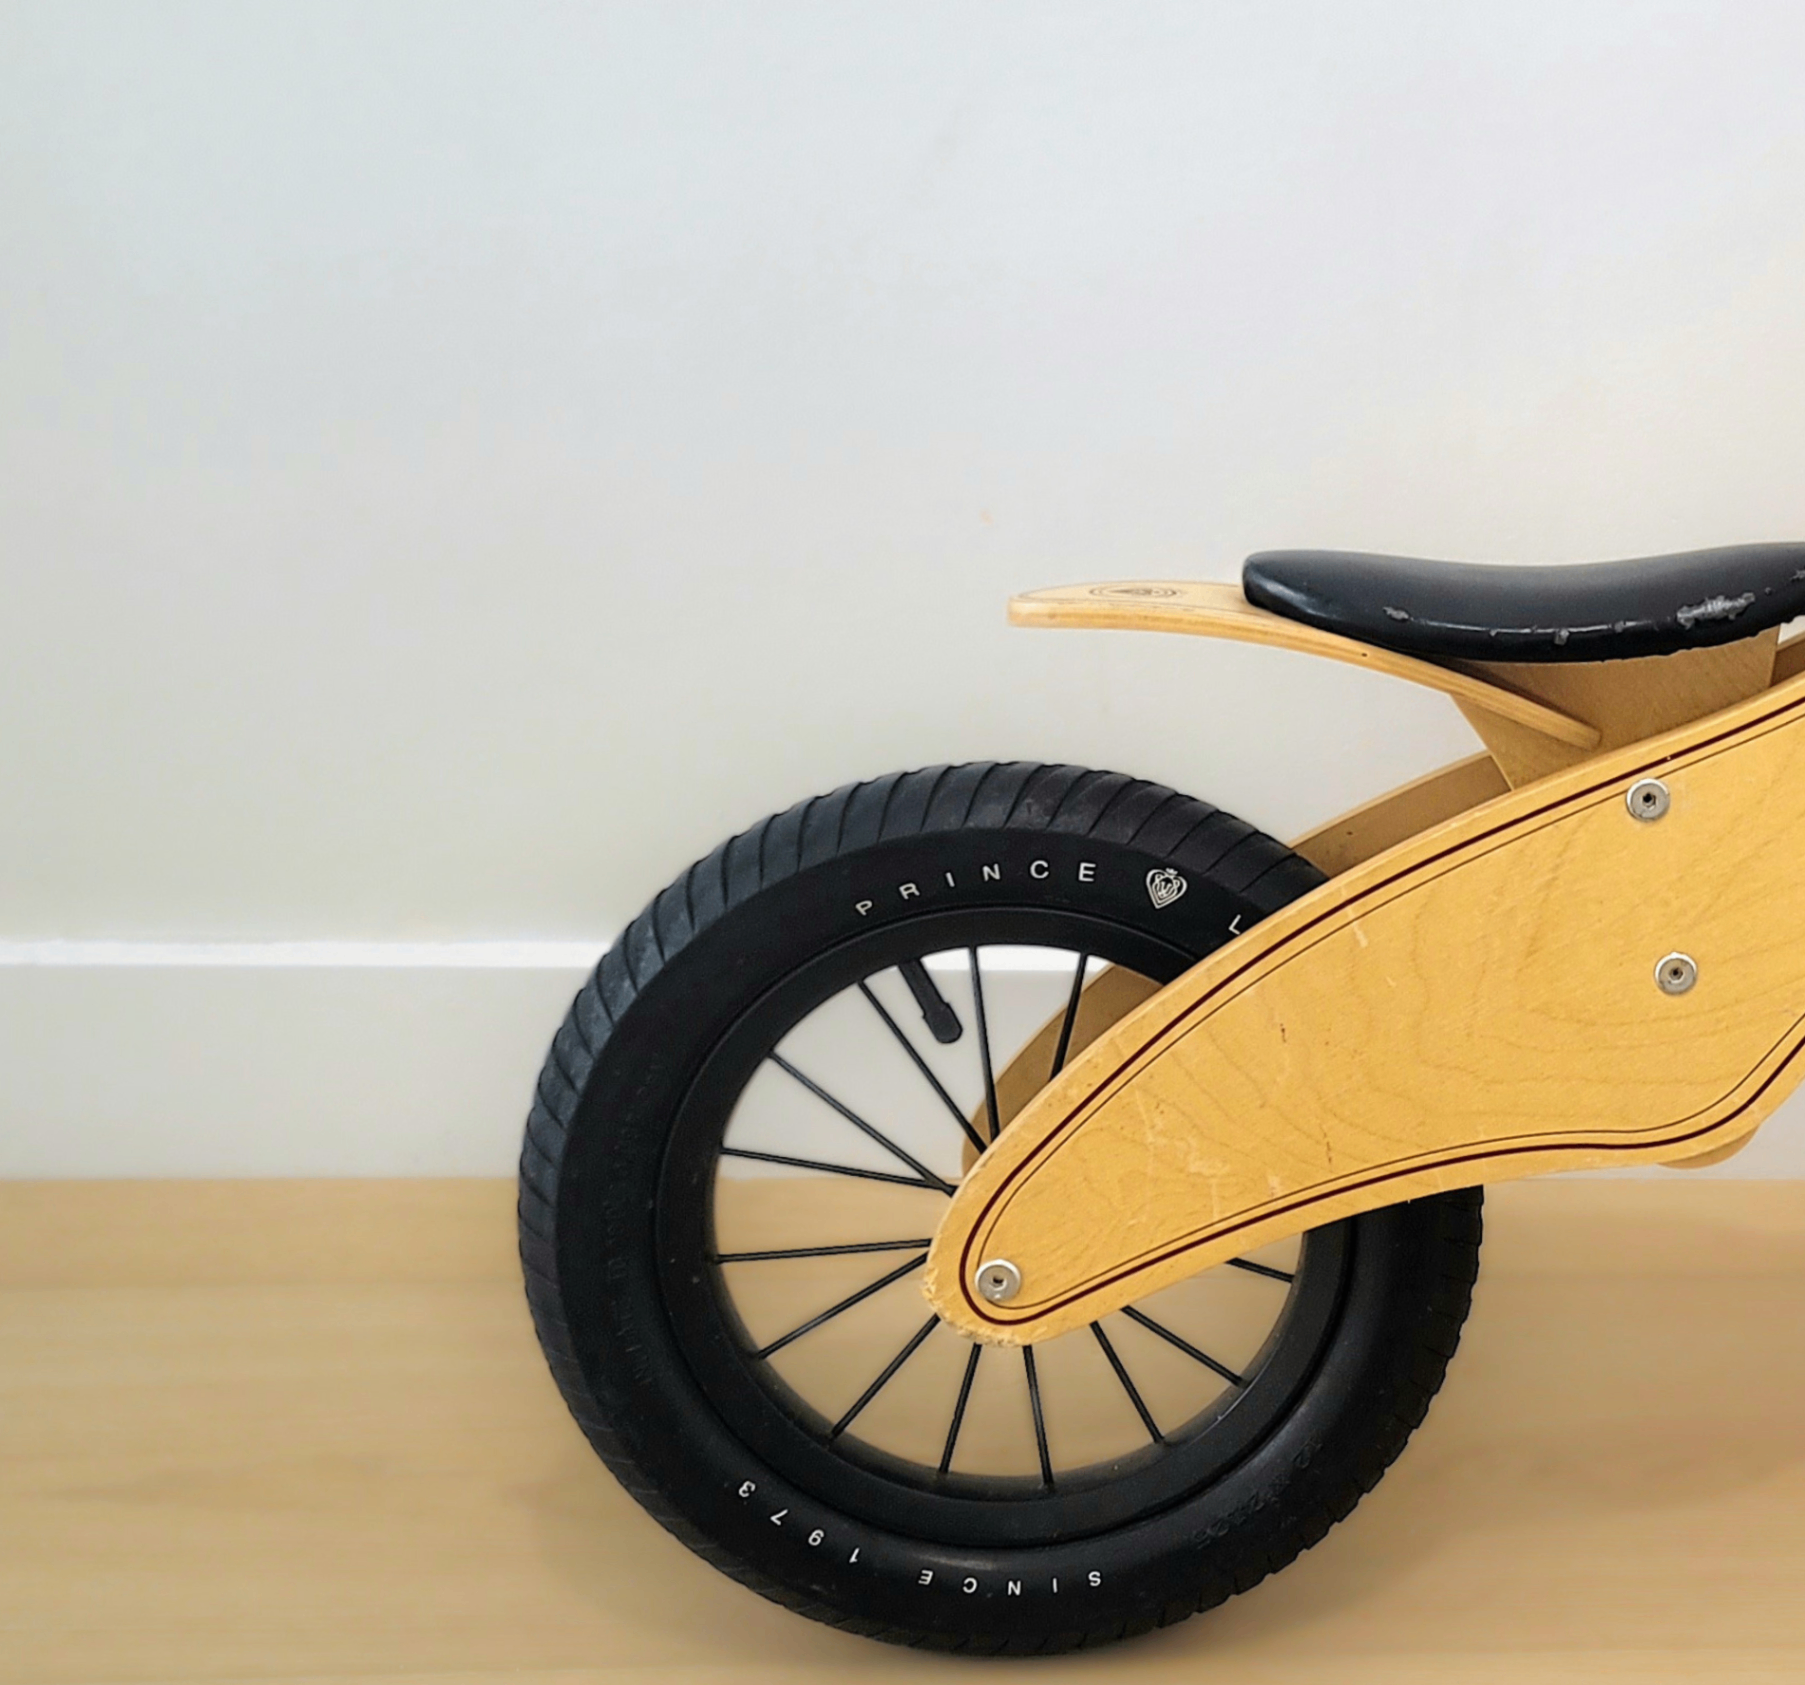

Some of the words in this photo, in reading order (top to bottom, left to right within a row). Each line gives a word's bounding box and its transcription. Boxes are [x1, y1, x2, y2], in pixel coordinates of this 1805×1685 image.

[855, 860, 1096, 916] PRINCE
[738, 1480, 860, 1563] 1973
[918, 1569, 1102, 1596] SINCE
